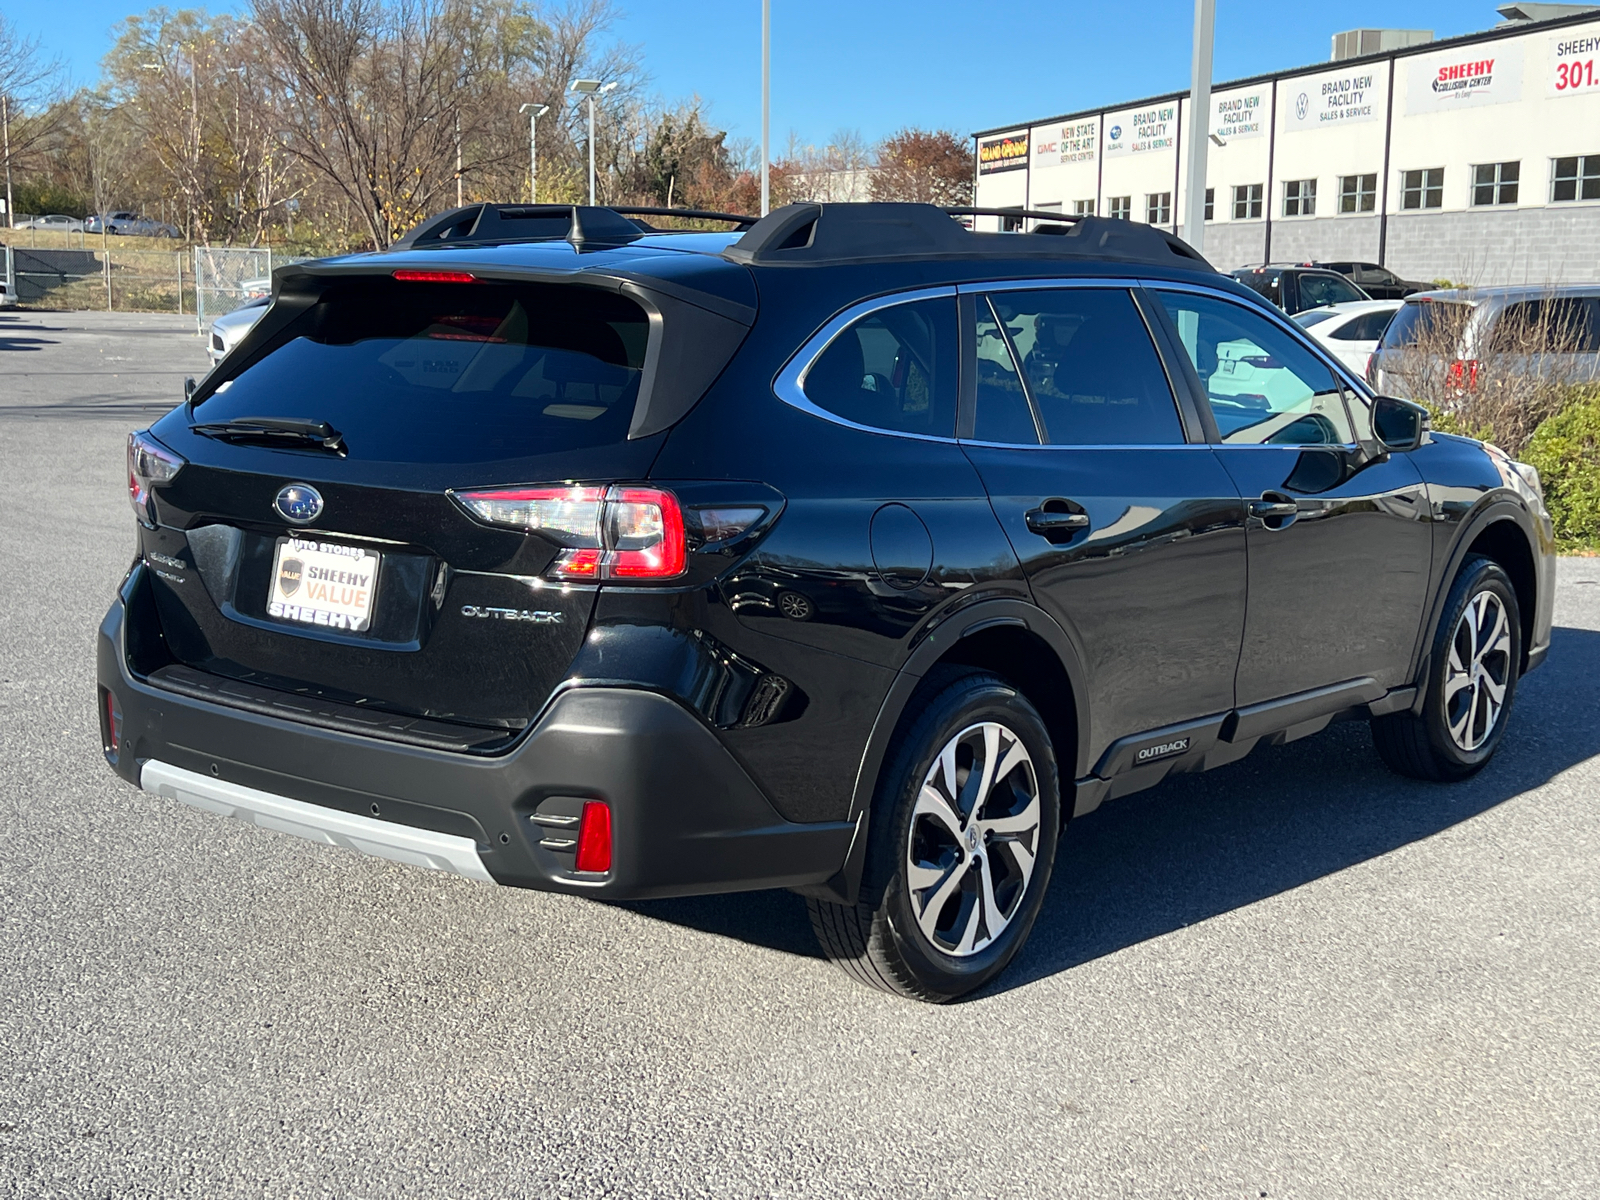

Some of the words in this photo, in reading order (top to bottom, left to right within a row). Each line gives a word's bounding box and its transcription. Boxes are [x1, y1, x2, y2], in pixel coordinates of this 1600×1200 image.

[1557, 37, 1600, 56] SHEEHY
[1438, 58, 1495, 81] SHEEHY
[1555, 59, 1599, 90] 301.
[1322, 79, 1350, 95] BRAND
[1353, 75, 1372, 90] NEW
[1438, 80, 1469, 92] COLLISION
[1469, 76, 1492, 88] CENTER
[1218, 99, 1242, 113] BRAND
[1244, 95, 1260, 109] NEW
[1328, 91, 1364, 108] FACILITY
[1133, 111, 1156, 126] BRAND
[1158, 108, 1174, 122] NEW
[1223, 109, 1253, 125] FACILITY
[1320, 110, 1338, 122] SALES
[1340, 109, 1344, 118] &
[1346, 106, 1371, 118] SERVICE
[1061, 126, 1075, 140] NEW
[1076, 123, 1095, 137] STATE
[1138, 123, 1167, 139] FACILITY
[1217, 126, 1232, 136] SALES
[1238, 123, 1259, 134] SERVICE
[1037, 142, 1057, 154] GMC
[1060, 141, 1068, 153] OF
[1070, 139, 1080, 152] THE
[1082, 137, 1094, 150] ART
[1132, 141, 1146, 152] SALES
[1152, 137, 1173, 149] SERVICE
[1060, 153, 1077, 163] SERVICE
[1078, 151, 1094, 161] CENTER
[288, 538, 317, 551] AUTO
[320, 543, 365, 558] STORES
[308, 566, 369, 587] SHEEHY
[307, 581, 367, 608] VALUE
[269, 602, 365, 631] SHEEHY
[461, 605, 563, 623] OUTBACK
[1138, 739, 1187, 759] OUTBACK
